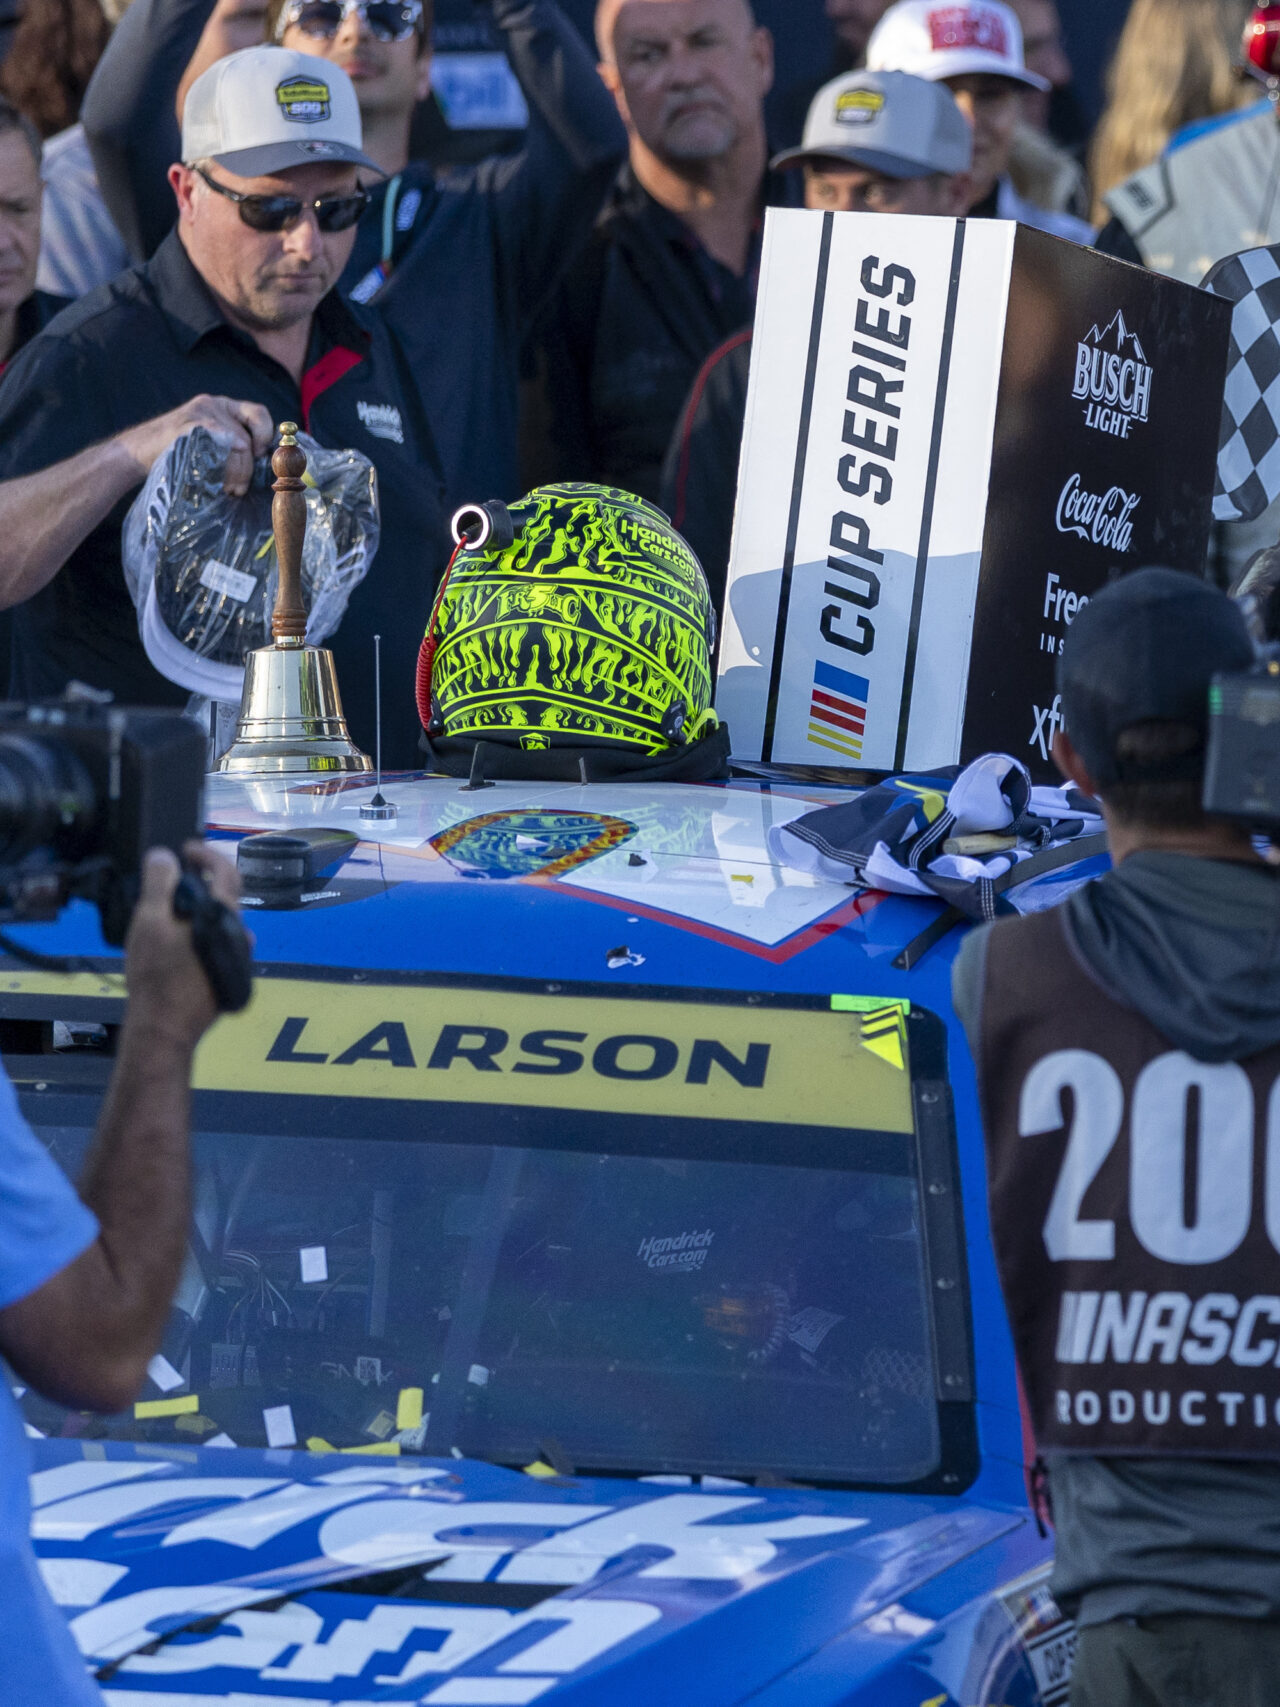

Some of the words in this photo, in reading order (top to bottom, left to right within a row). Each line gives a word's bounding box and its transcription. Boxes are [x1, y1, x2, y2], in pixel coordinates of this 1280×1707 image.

[837, 255, 916, 505] SERIES
[1072, 342, 1153, 423] BUSCH
[1084, 403, 1132, 439] LIGHT
[621, 519, 699, 568] Hendrick
[639, 539, 696, 580] Cars.com
[819, 510, 884, 656] CUP
[1040, 633, 1065, 656] INS
[266, 1016, 771, 1088] LARSON
[637, 1229, 715, 1260] Hendrick
[648, 1249, 708, 1268] Cars.com
